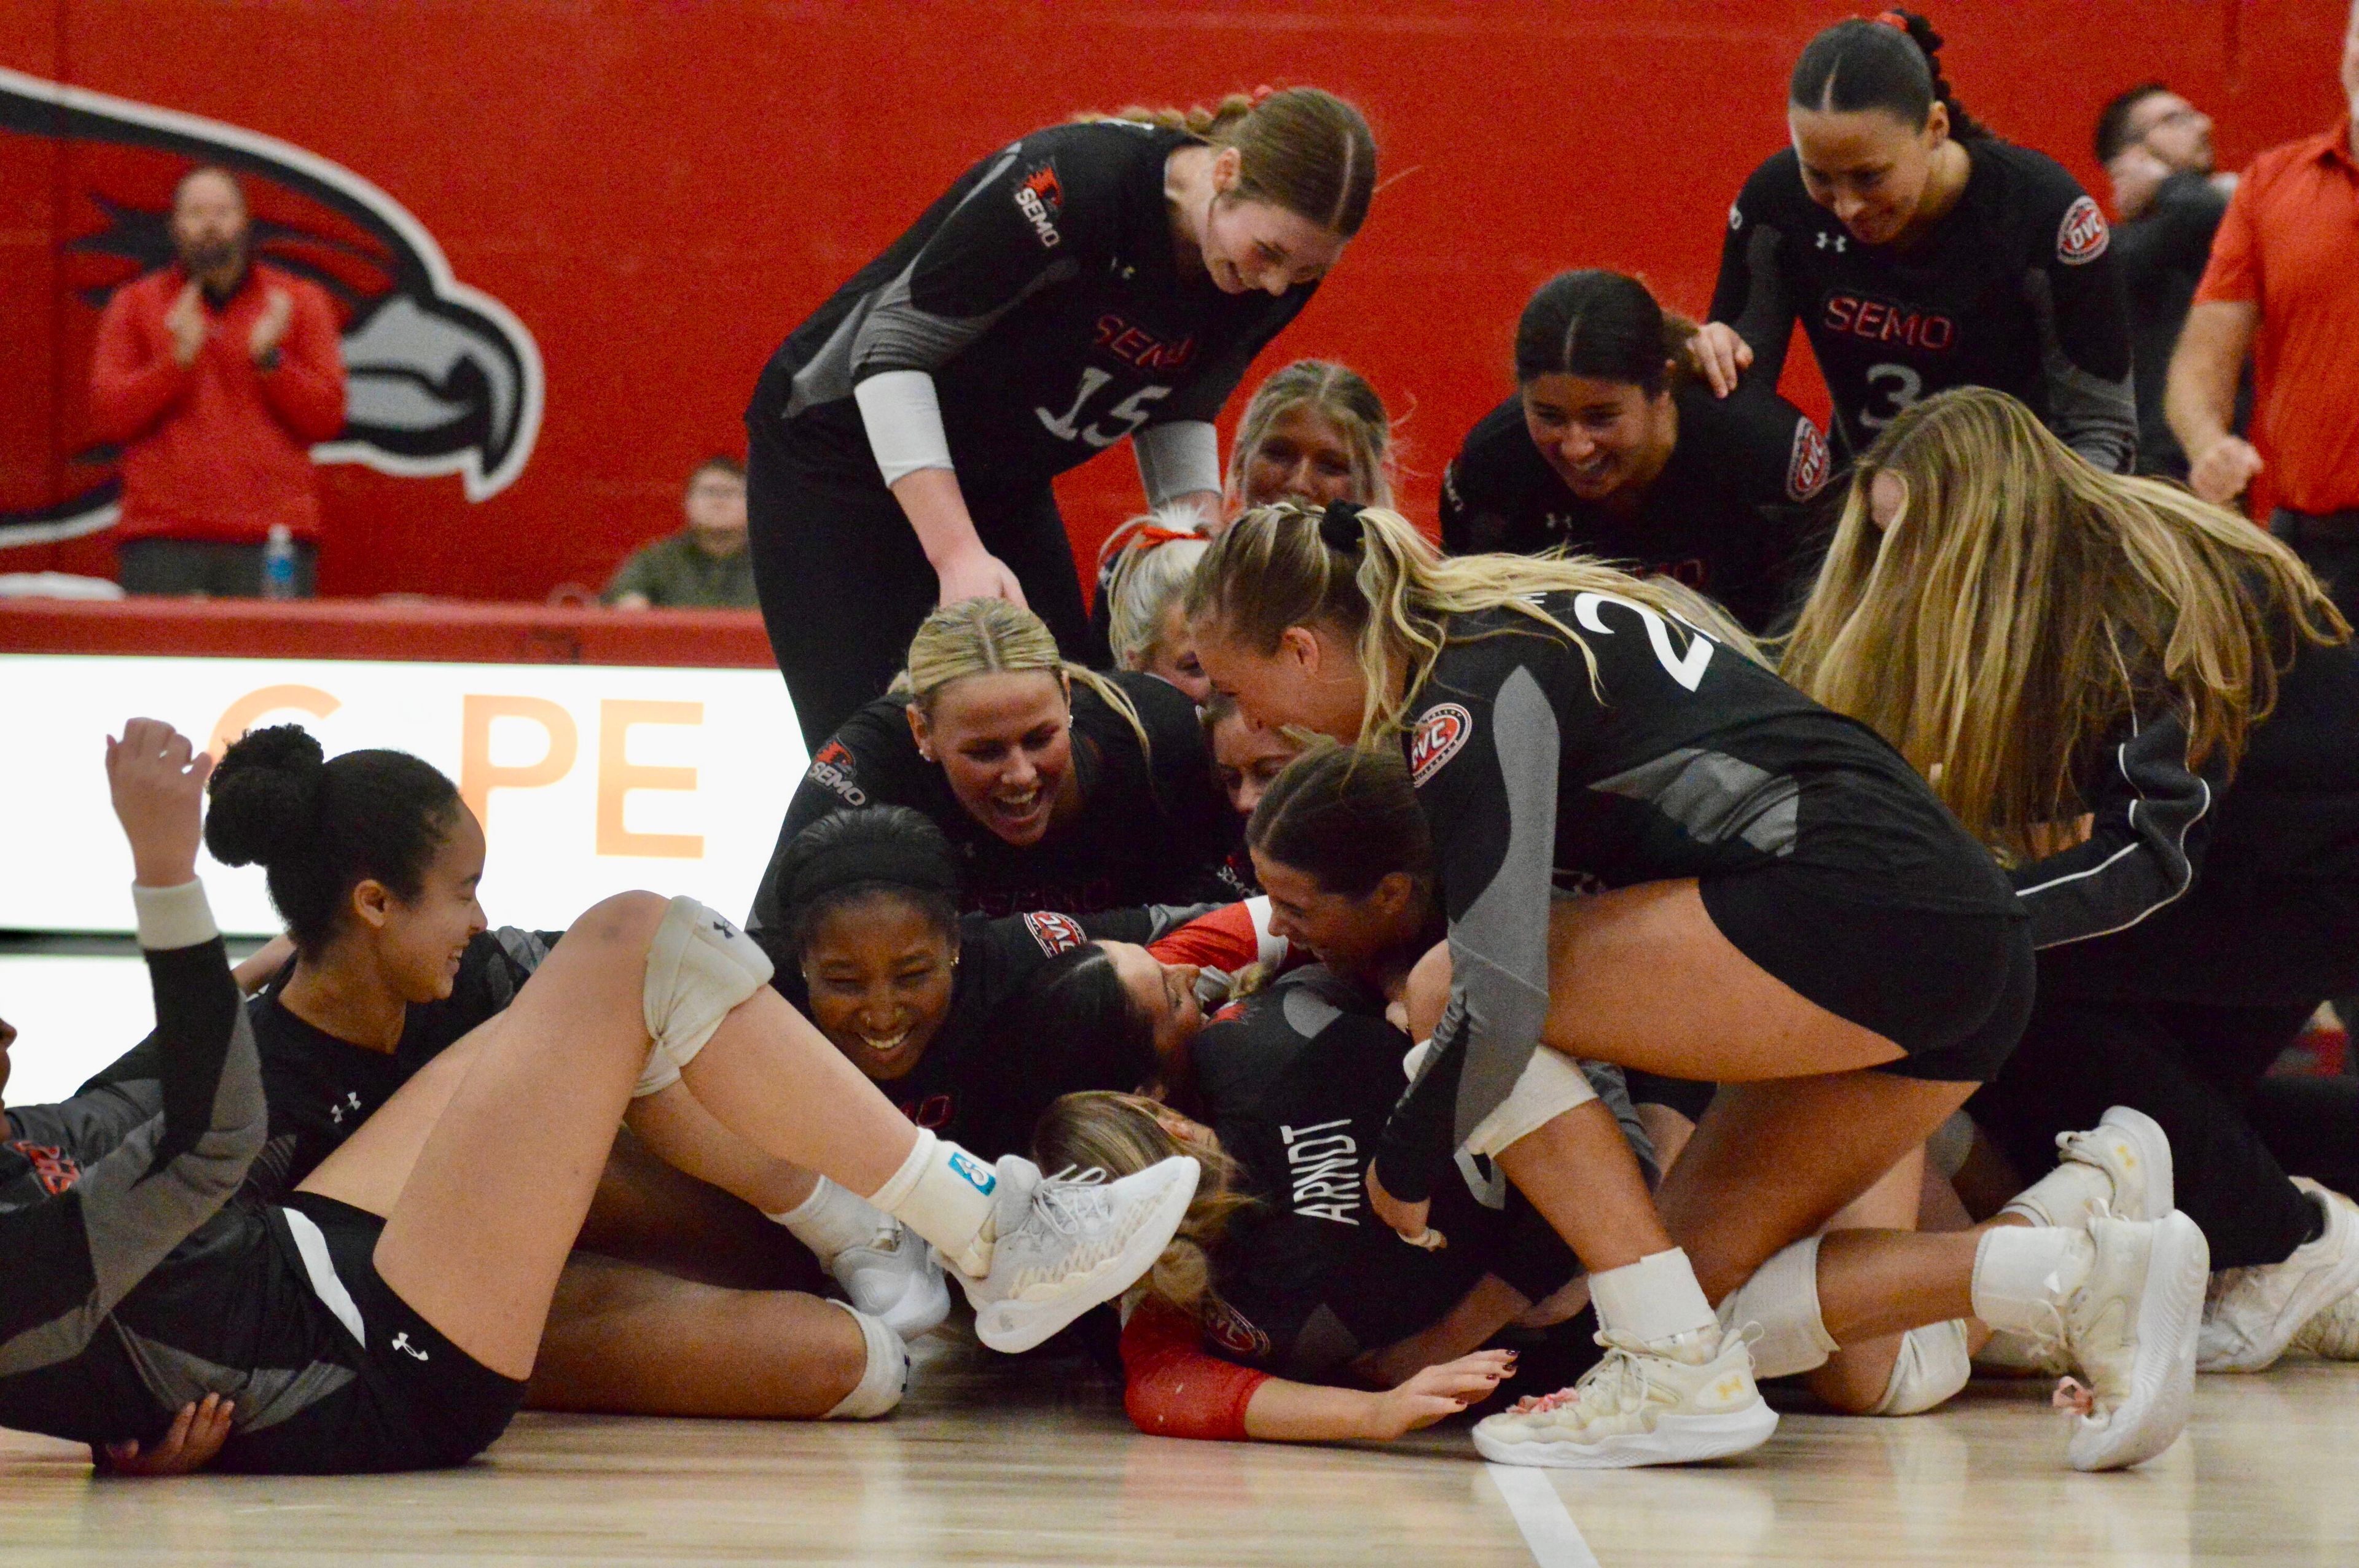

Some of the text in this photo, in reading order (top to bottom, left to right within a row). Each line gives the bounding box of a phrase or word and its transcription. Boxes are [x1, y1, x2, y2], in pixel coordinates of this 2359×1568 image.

[1015, 187, 1061, 248] SEMO
[2071, 211, 2100, 249] OVC
[1825, 296, 1953, 349] SEMO
[1034, 366, 1173, 447] 15
[1859, 362, 1922, 429] 3
[807, 762, 866, 806] SEMO
[1280, 1118, 1360, 1226] ARNDT
